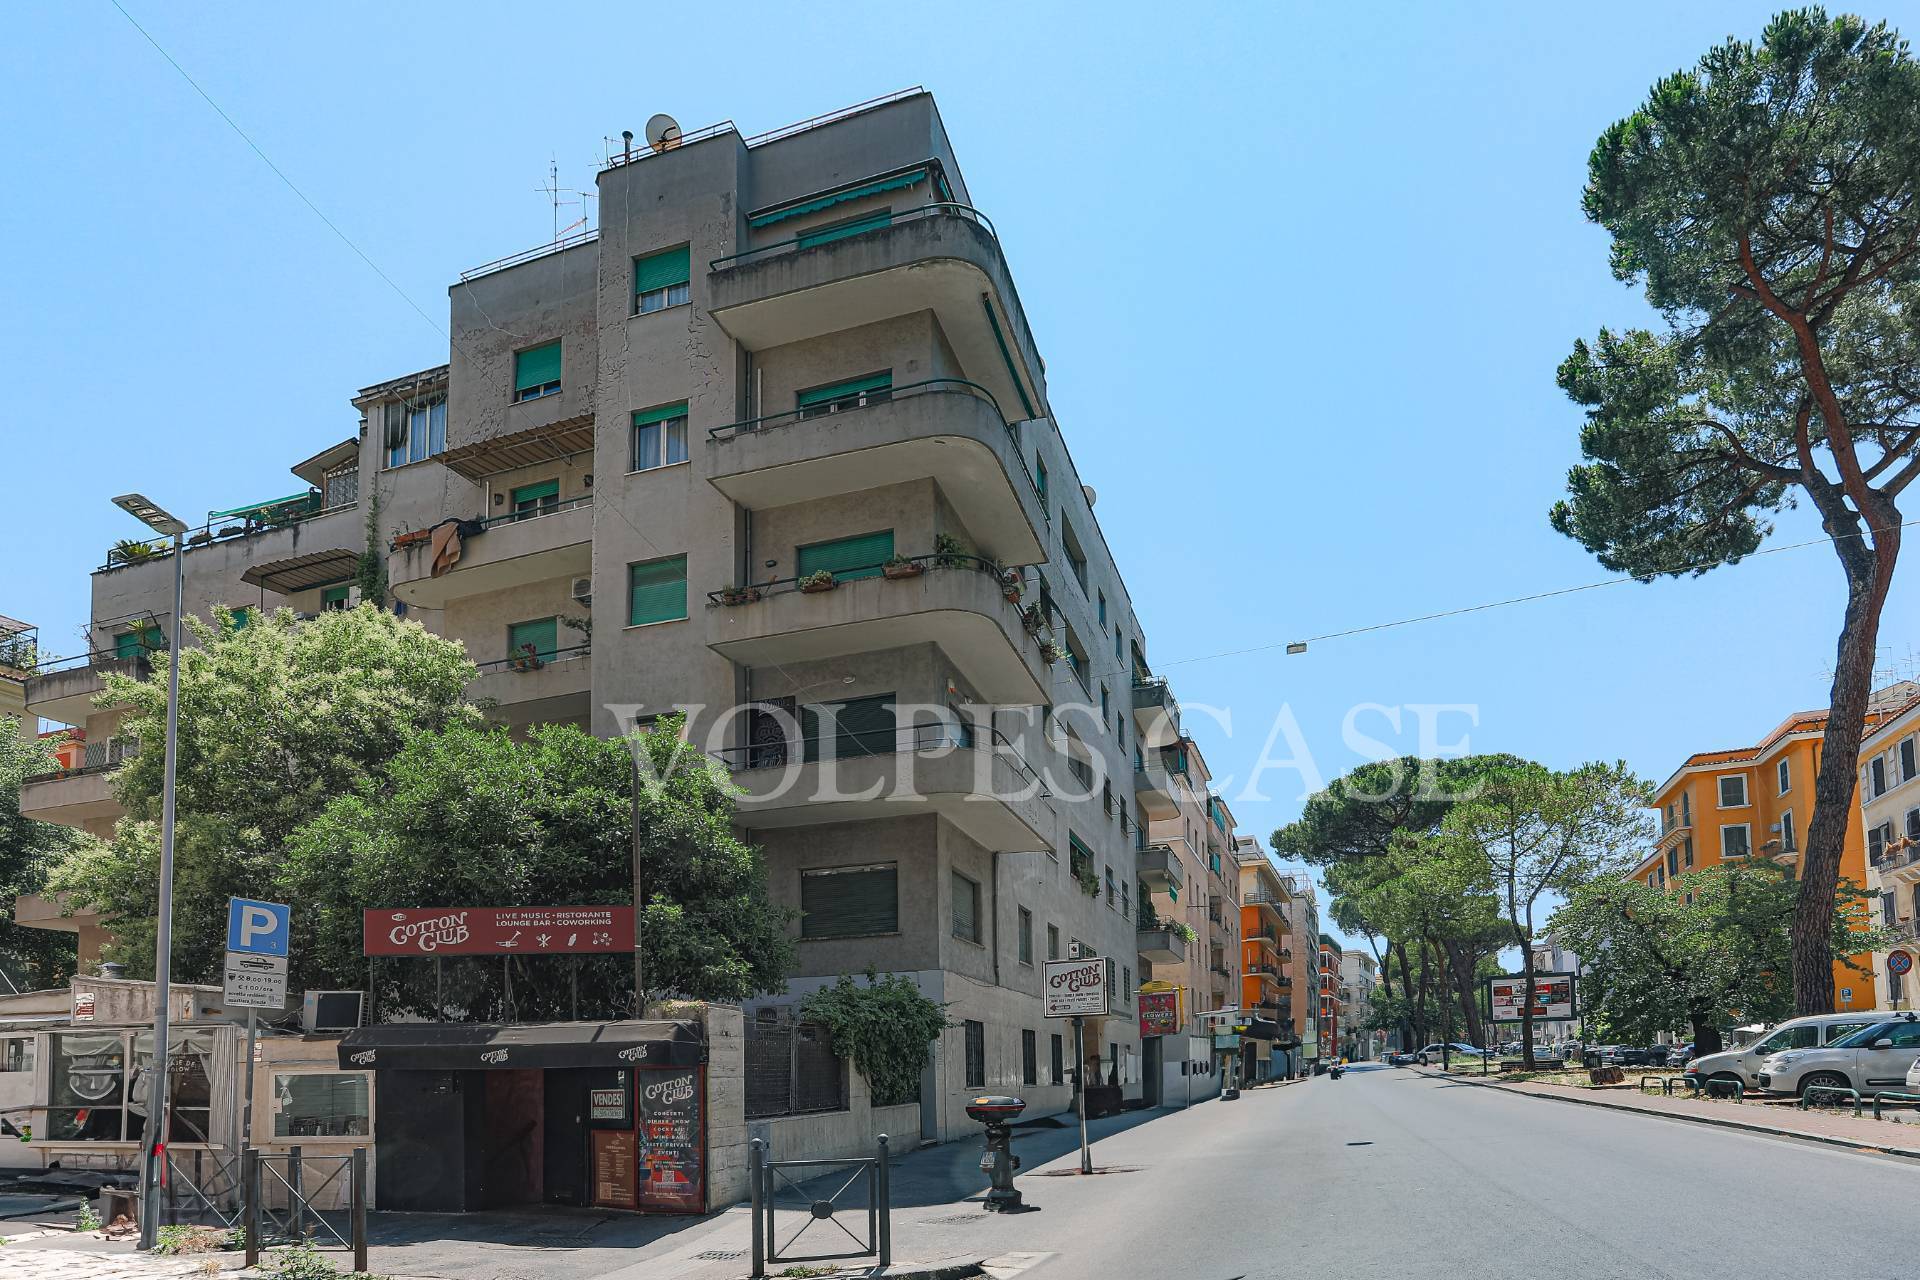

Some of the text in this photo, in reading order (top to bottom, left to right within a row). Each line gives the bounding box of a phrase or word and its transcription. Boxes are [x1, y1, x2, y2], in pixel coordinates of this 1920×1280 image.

[240, 905, 278, 947] P
[389, 912, 468, 945] COTTON
[556, 918, 612, 926] COWORKING
[418, 925, 469, 951] CLUB
[1050, 963, 1100, 988] COTTON
[1068, 974, 1101, 992] CLUB
[645, 1074, 693, 1099] COTTON
[661, 1085, 694, 1104] CLUB
[593, 1093, 623, 1106] VENDESI
